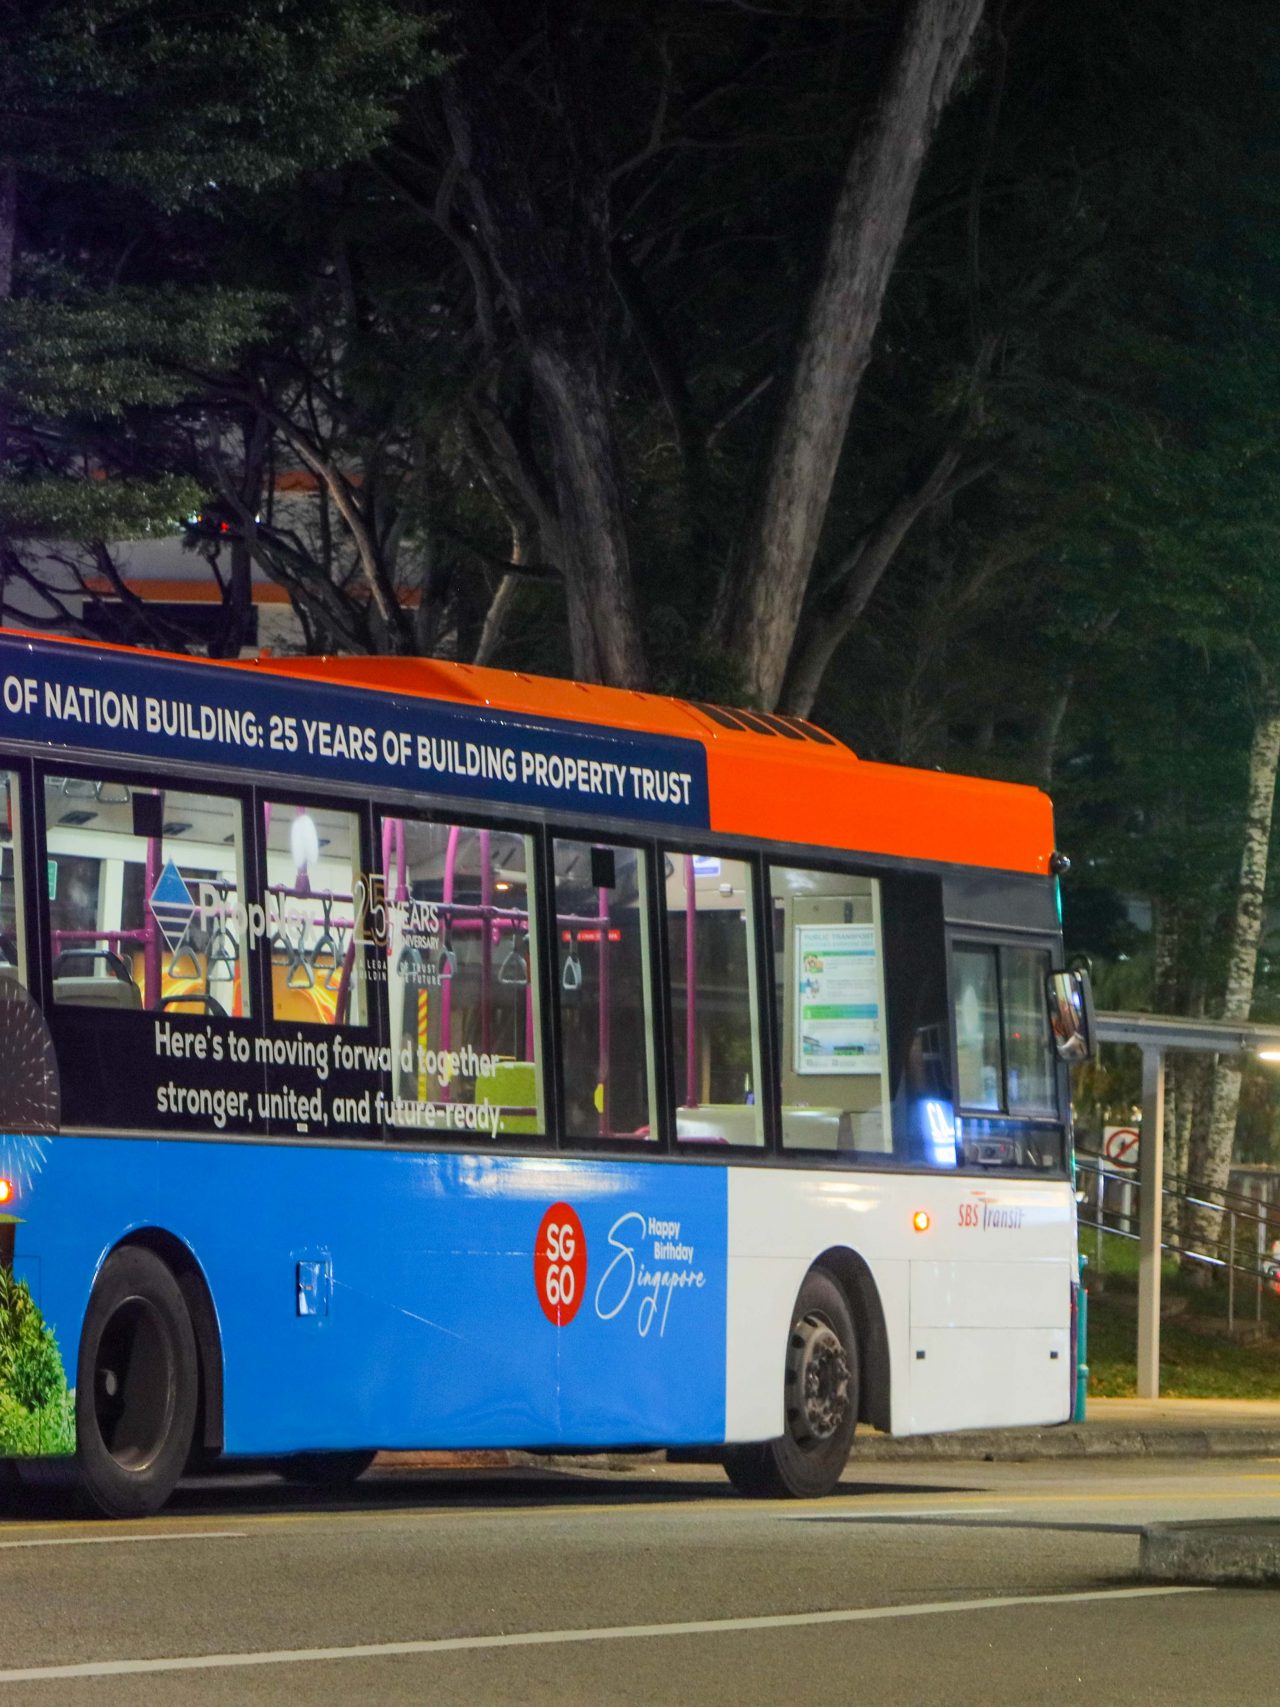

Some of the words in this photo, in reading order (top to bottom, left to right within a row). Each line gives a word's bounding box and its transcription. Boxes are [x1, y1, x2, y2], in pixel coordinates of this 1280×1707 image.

[4, 674, 38, 715] OF
[44, 681, 139, 731] NATION
[145, 696, 264, 748] BUILDING:
[269, 714, 299, 752] 25
[302, 719, 378, 763] YEARS
[382, 729, 412, 768] OF
[418, 734, 517, 783] BUILDING
[521, 751, 626, 799] PROPERTY
[630, 765, 692, 806] TRUST
[199, 882, 317, 950] PropNex
[352, 873, 390, 947] 25
[155, 1021, 223, 1061] Here's
[228, 1031, 250, 1062] to
[255, 1031, 329, 1080] moving
[333, 1035, 412, 1073] forward
[417, 1044, 501, 1087] together
[157, 1081, 253, 1128] stronger,
[258, 1085, 329, 1126] united,
[333, 1090, 370, 1126] and
[375, 1092, 505, 1139] future-ready.
[545, 1223, 575, 1262] SG
[648, 1217, 680, 1240] Happy
[958, 1203, 978, 1227] SBS
[978, 1198, 1025, 1232] Transit
[595, 1211, 706, 1337] Singapore
[654, 1241, 694, 1263] Birthday
[545, 1264, 575, 1304] 60
